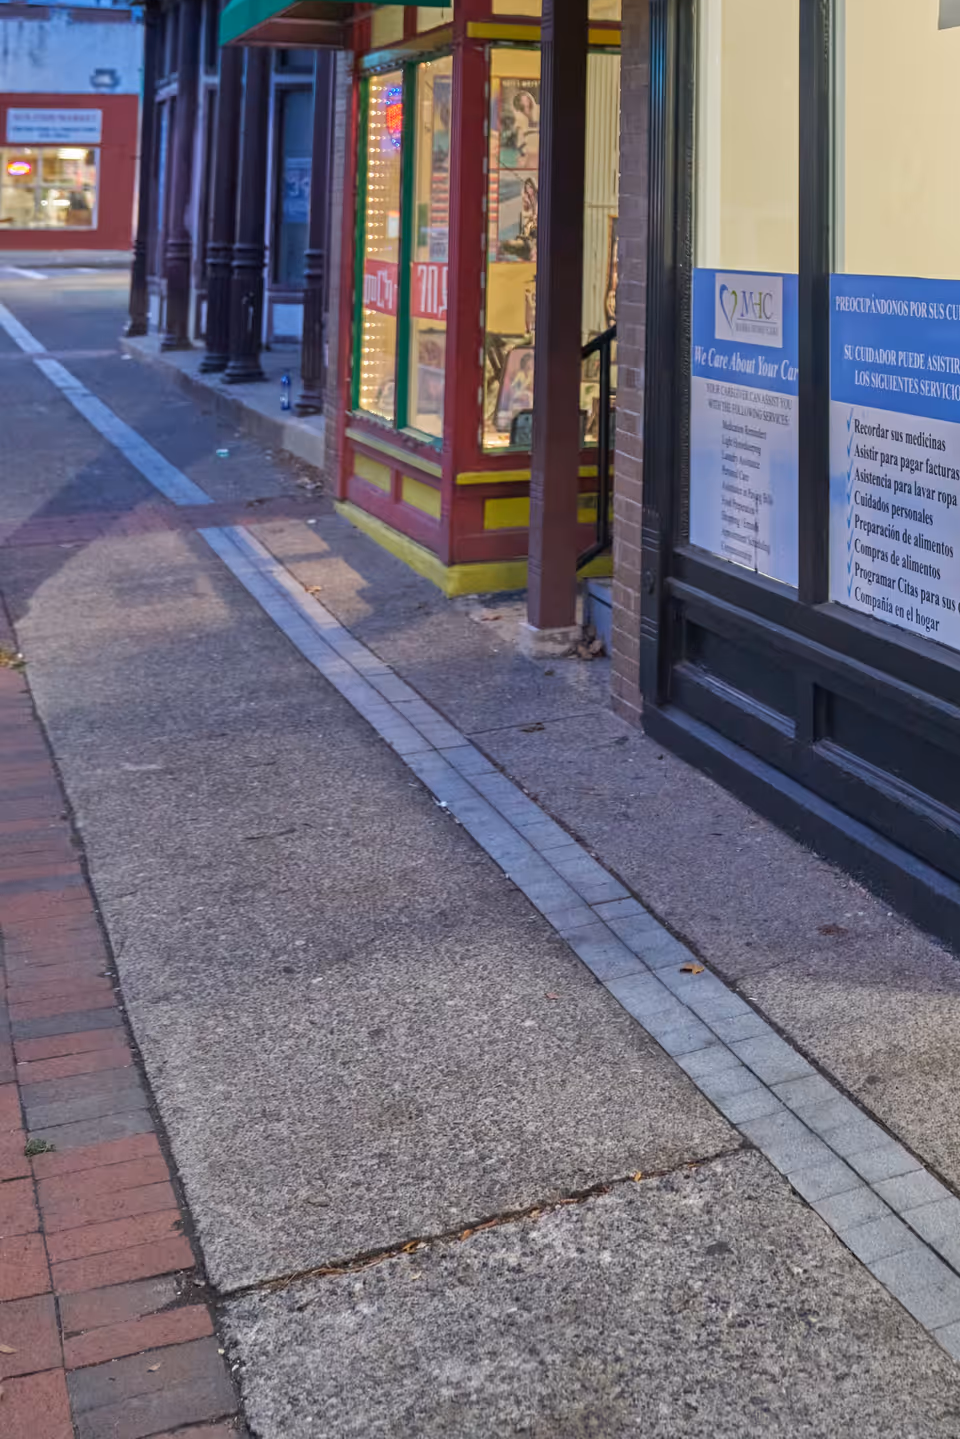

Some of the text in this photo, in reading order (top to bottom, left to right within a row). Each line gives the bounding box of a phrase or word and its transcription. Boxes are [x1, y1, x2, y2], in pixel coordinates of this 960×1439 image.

[835, 294, 908, 317] PREOCUPÁNDONOS
[910, 301, 927, 318] POR
[929, 303, 945, 319] SUS
[695, 346, 705, 365] We
[708, 348, 728, 369] Care
[729, 352, 756, 373] About
[757, 356, 779, 378] Your
[844, 344, 854, 360] SU
[855, 345, 897, 366] CUIDADOR
[898, 351, 925, 370] PUEDE
[927, 354, 960, 375] ASISTIR
[855, 370, 870, 387] LOS
[871, 373, 919, 394] SIGUIENTES
[854, 419, 946, 452] Recordar sus medicinas
[854, 443, 960, 481] Asistir para pagar facturas
[854, 467, 958, 509] Asistencia para lavar ropa
[854, 490, 934, 526] Cuidados personales
[855, 514, 954, 558] Preparación de alimentos
[854, 538, 941, 580] Compras de alimentos
[855, 562, 896, 590] Programar
[898, 577, 918, 598] Citas
[921, 589, 940, 606] para
[942, 596, 956, 611] sus
[855, 586, 940, 632] Compañía en el hogar
